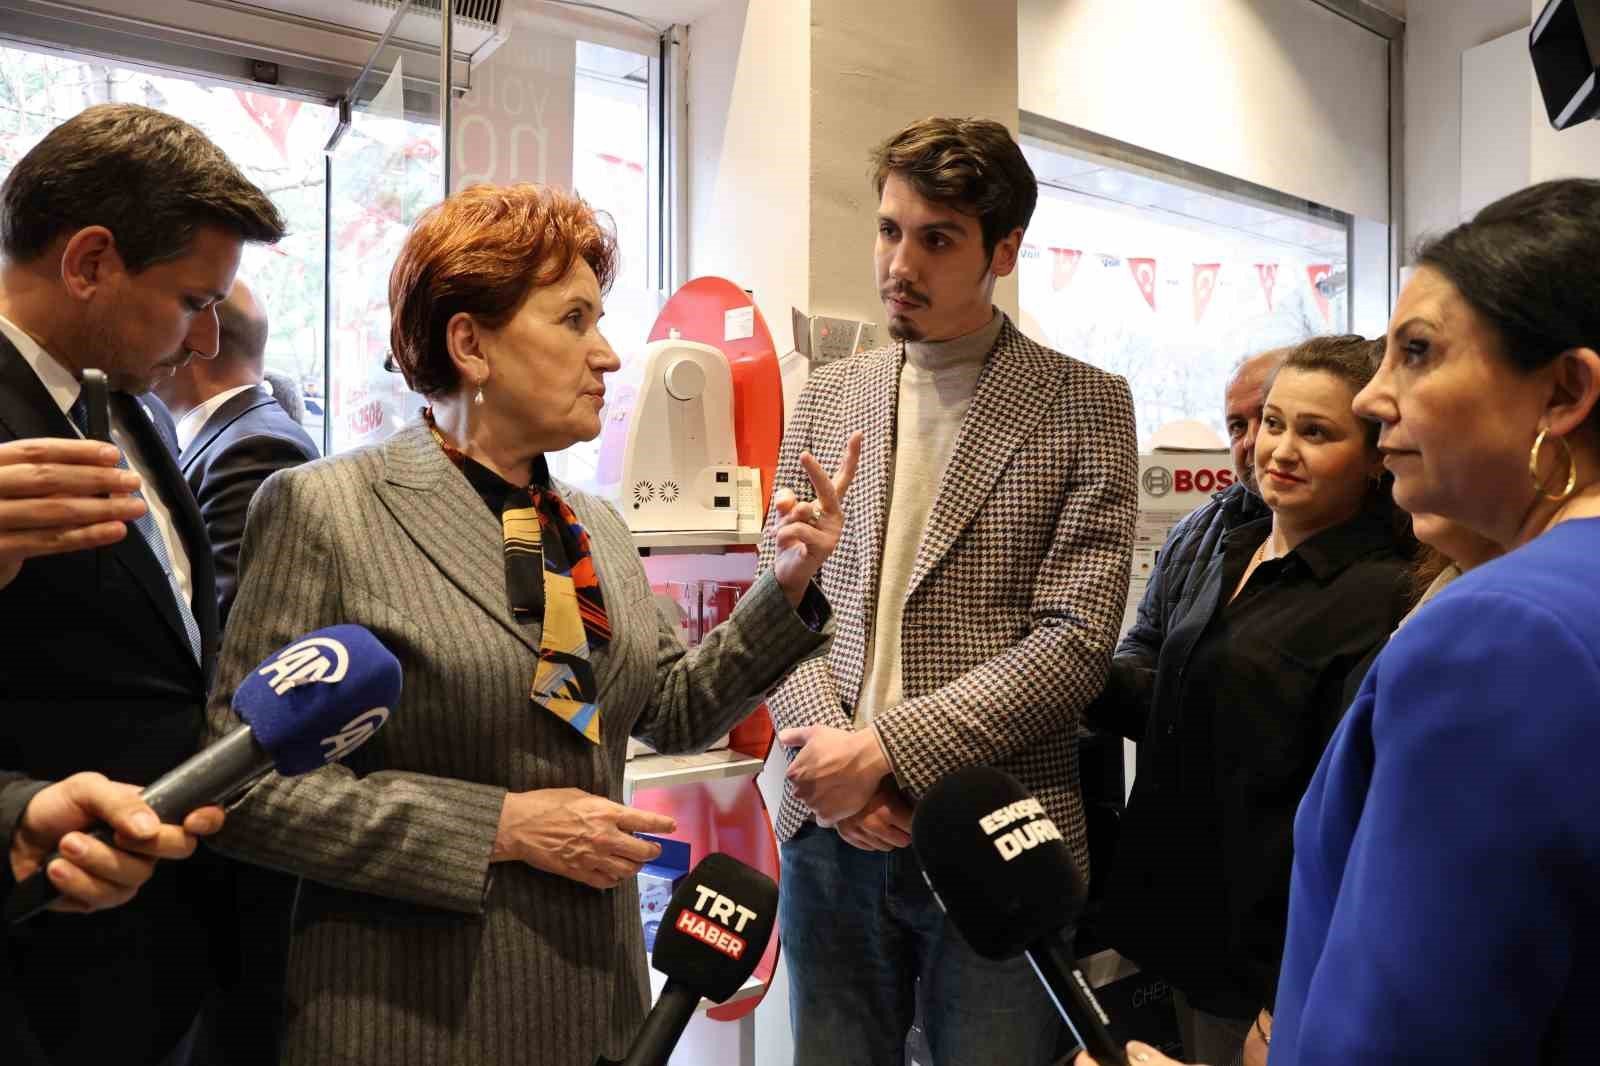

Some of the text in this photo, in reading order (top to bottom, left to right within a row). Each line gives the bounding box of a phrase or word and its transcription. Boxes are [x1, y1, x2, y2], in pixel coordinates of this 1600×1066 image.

[1174, 469, 1238, 492] BOS
[695, 885, 757, 932] TRT
[679, 912, 742, 956] HABER
